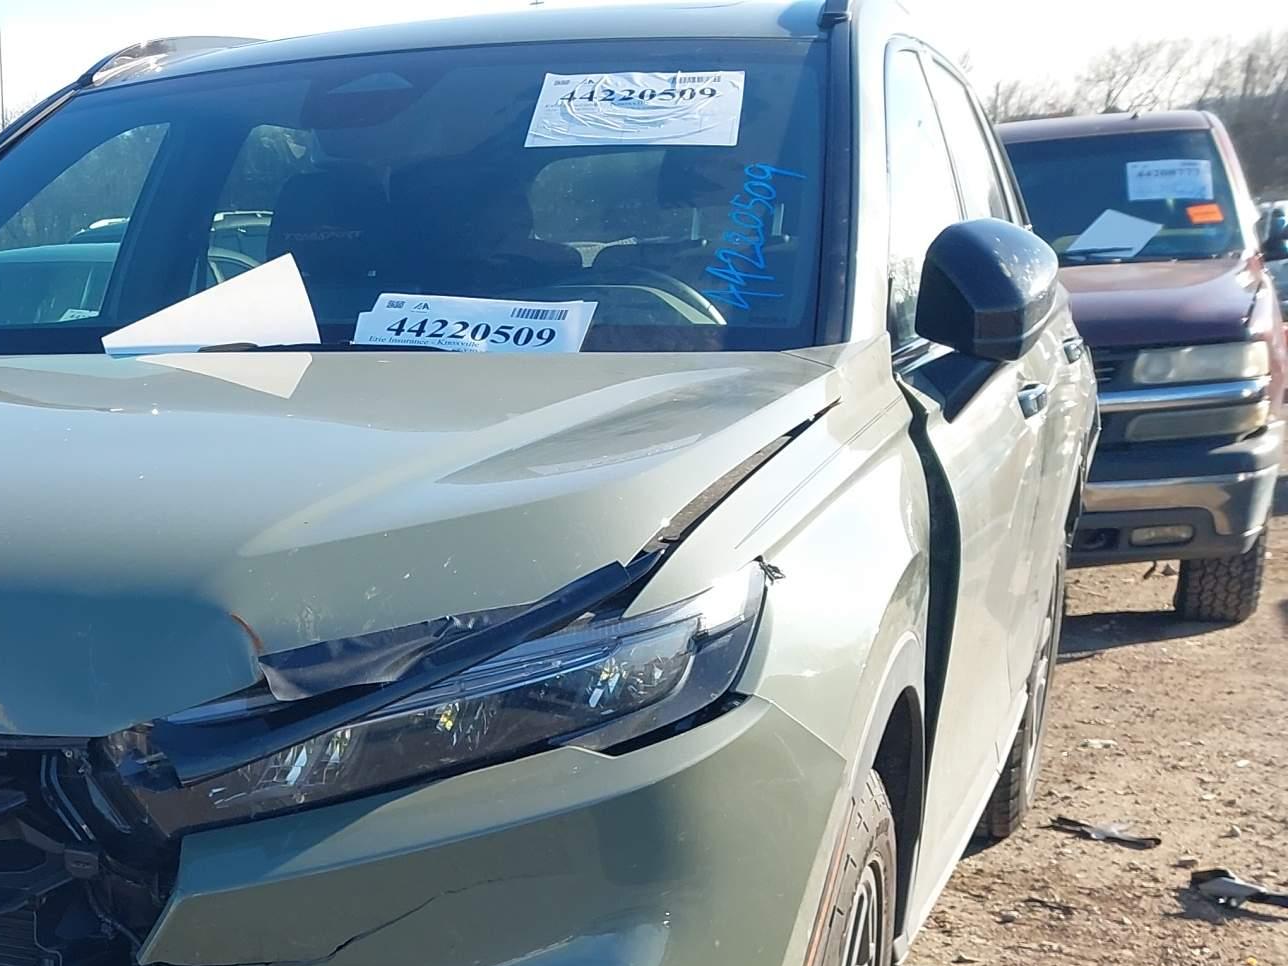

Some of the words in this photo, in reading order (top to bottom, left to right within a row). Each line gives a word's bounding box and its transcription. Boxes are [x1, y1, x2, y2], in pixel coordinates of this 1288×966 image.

[559, 87, 717, 103] 44220509
[386, 317, 556, 347] 44220509
[389, 335, 430, 345] Insurance
